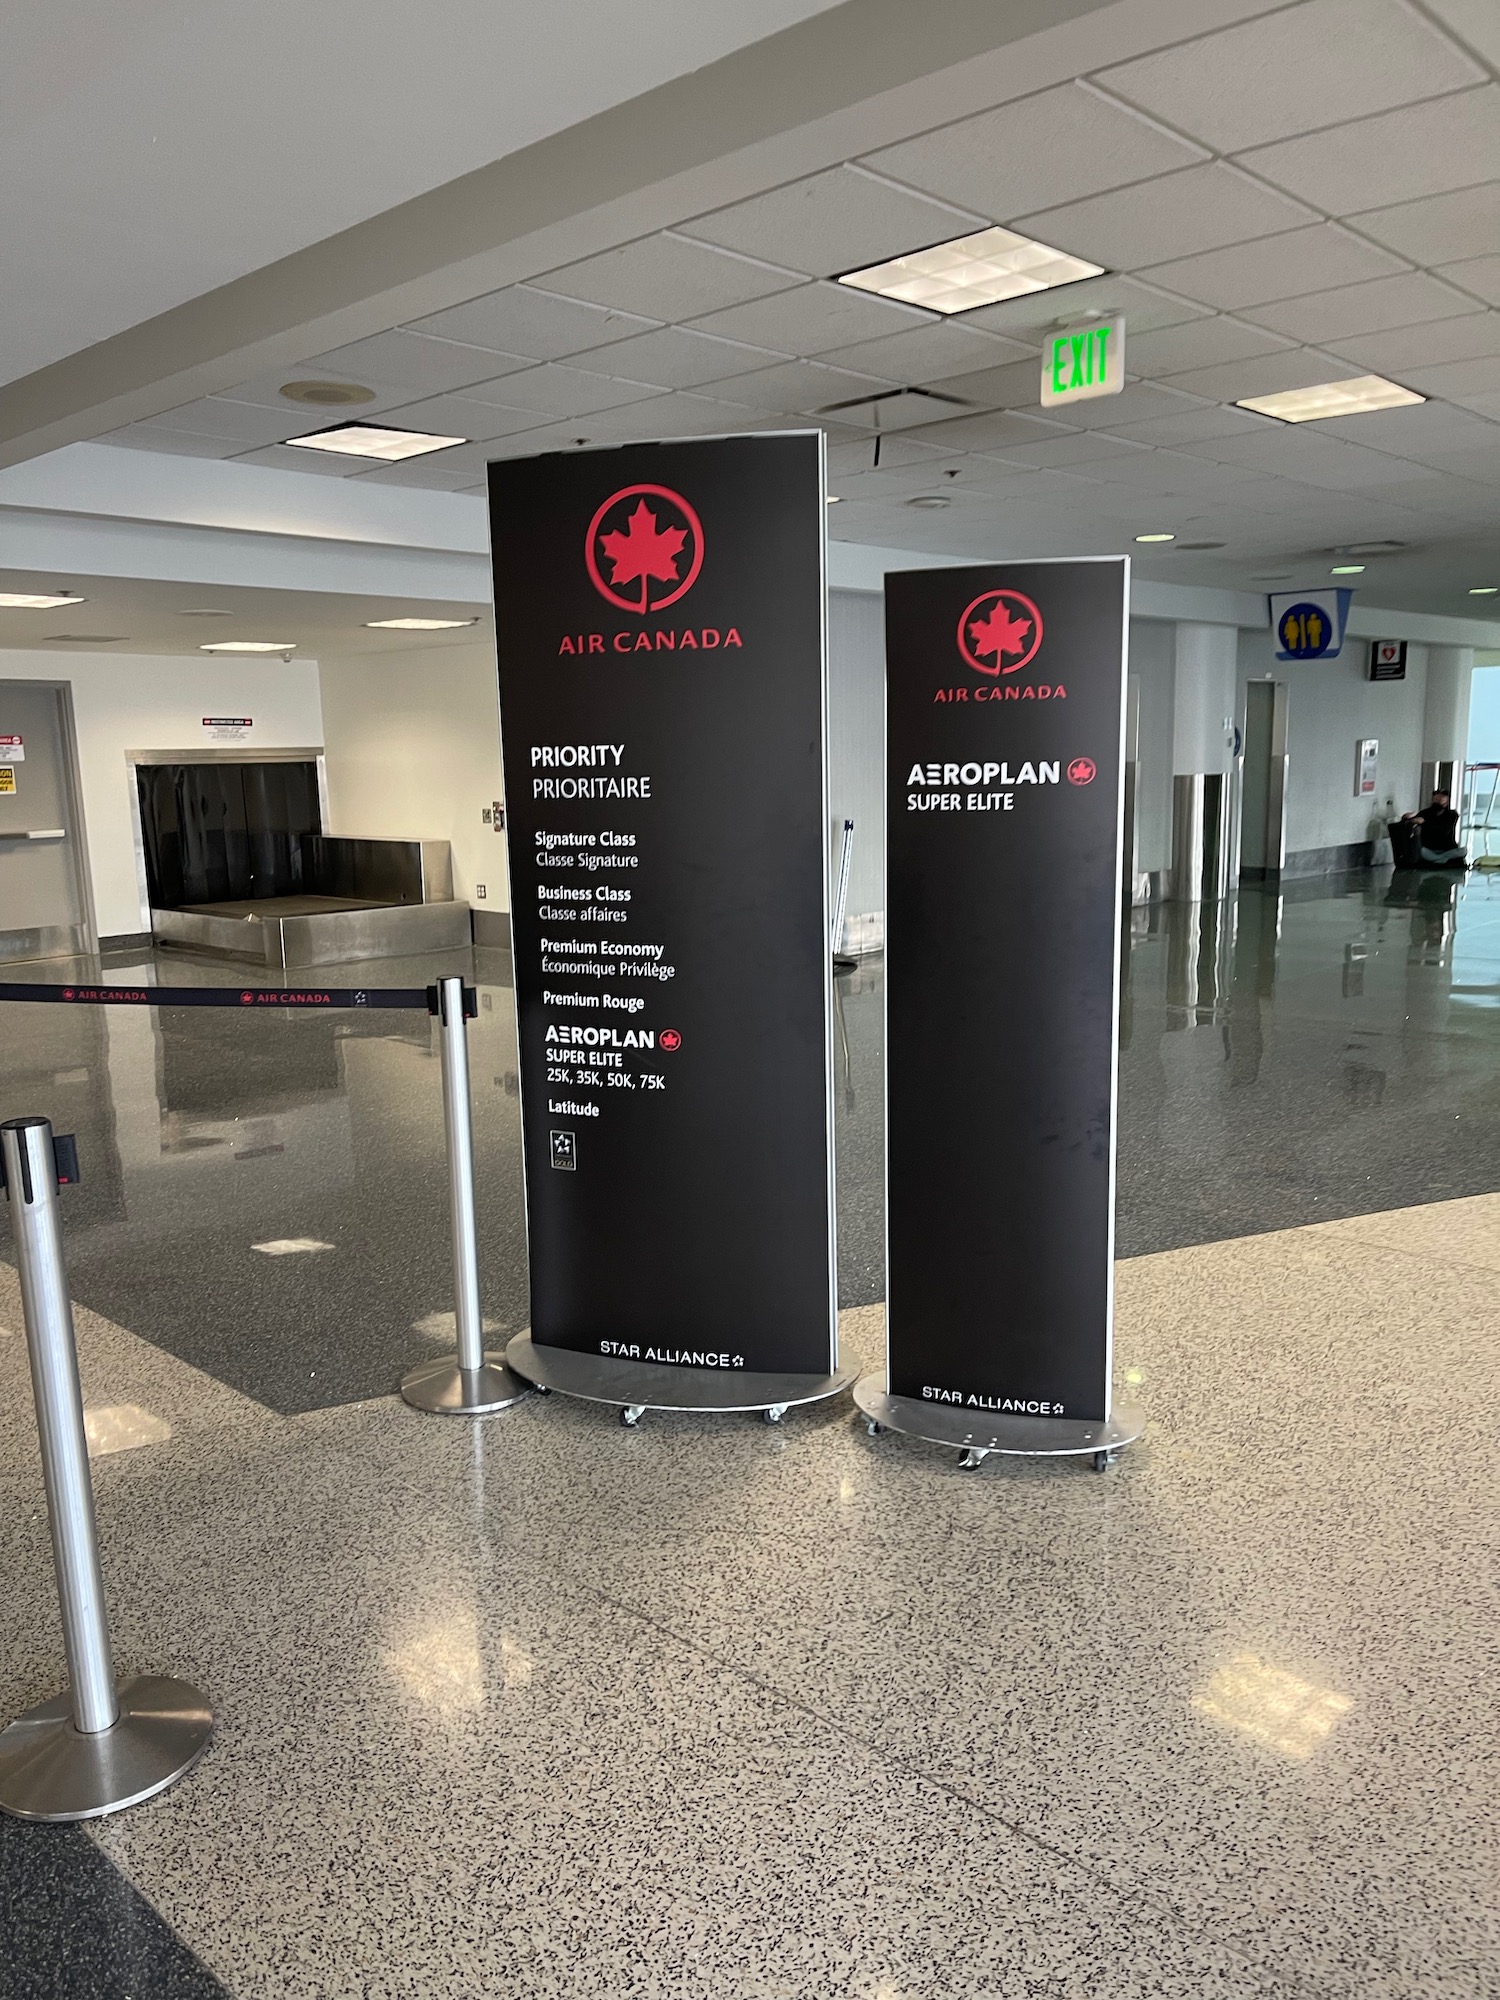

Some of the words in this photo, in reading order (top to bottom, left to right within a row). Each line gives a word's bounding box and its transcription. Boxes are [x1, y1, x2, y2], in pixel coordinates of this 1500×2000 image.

[1052, 327, 1111, 394] EXIT
[558, 634, 607, 656] AIR
[613, 627, 743, 654] CANADA
[934, 686, 969, 703] AIR
[974, 684, 1067, 702] CANADA
[530, 744, 625, 767] PRIORITY
[906, 761, 1060, 786] AEROPLAN
[532, 776, 652, 799] PRIORITAIRE
[907, 793, 962, 811] SUPER
[966, 792, 1014, 811] ELITE
[535, 831, 596, 850] Signature
[599, 831, 636, 846] Class
[535, 852, 574, 867] Classe
[577, 852, 639, 871] Signature
[537, 885, 592, 900] Business
[595, 886, 632, 901] Class
[538, 905, 577, 920] Classe
[580, 906, 628, 922] affaires
[540, 938, 597, 955] Premium
[600, 940, 664, 960] Economy
[541, 956, 616, 979] Économique
[619, 961, 676, 981] Privilège
[78, 990, 98, 1000] AIR
[100, 990, 147, 1001] CANADA
[257, 993, 278, 1003] AIR
[280, 993, 331, 1003] CANADA
[543, 990, 600, 1008] Premium
[602, 993, 645, 1013] Rouge
[545, 1024, 655, 1049] AEROPLAN
[546, 1048, 586, 1065] SUPER
[588, 1051, 623, 1067] ELITE
[547, 1067, 573, 1084] 25K,
[576, 1070, 603, 1087] 35K,
[607, 1072, 636, 1090] 50K,
[639, 1074, 666, 1090] 75K
[548, 1099, 600, 1117] Latitude
[600, 1340, 640, 1358] STAR
[645, 1347, 730, 1367] ALLIANCE
[922, 1386, 962, 1404] STAR
[967, 1394, 1050, 1414] ALLIANCE
